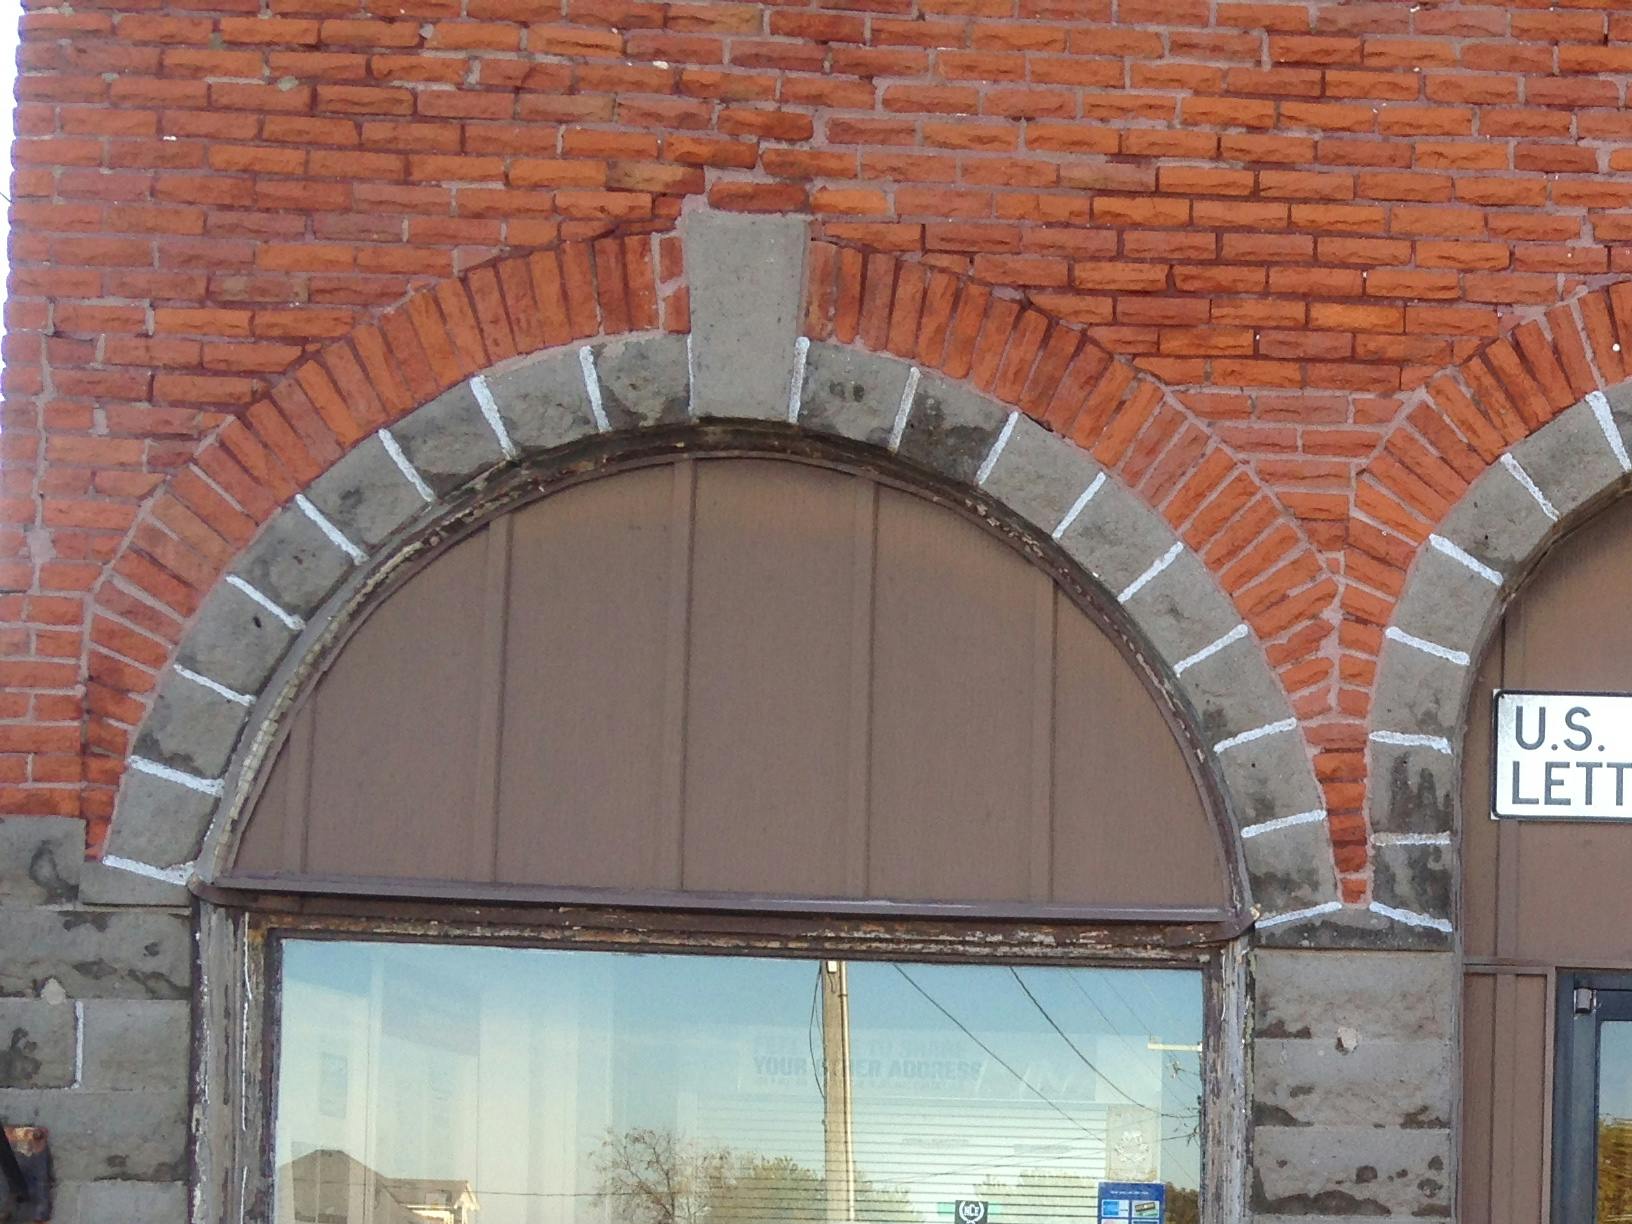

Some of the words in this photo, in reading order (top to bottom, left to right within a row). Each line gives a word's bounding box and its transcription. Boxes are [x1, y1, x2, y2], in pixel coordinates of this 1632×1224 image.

[1515, 706, 1605, 752] U.S.
[753, 1056, 807, 1076] YOUR
[888, 1059, 982, 1081] ADDRESS
